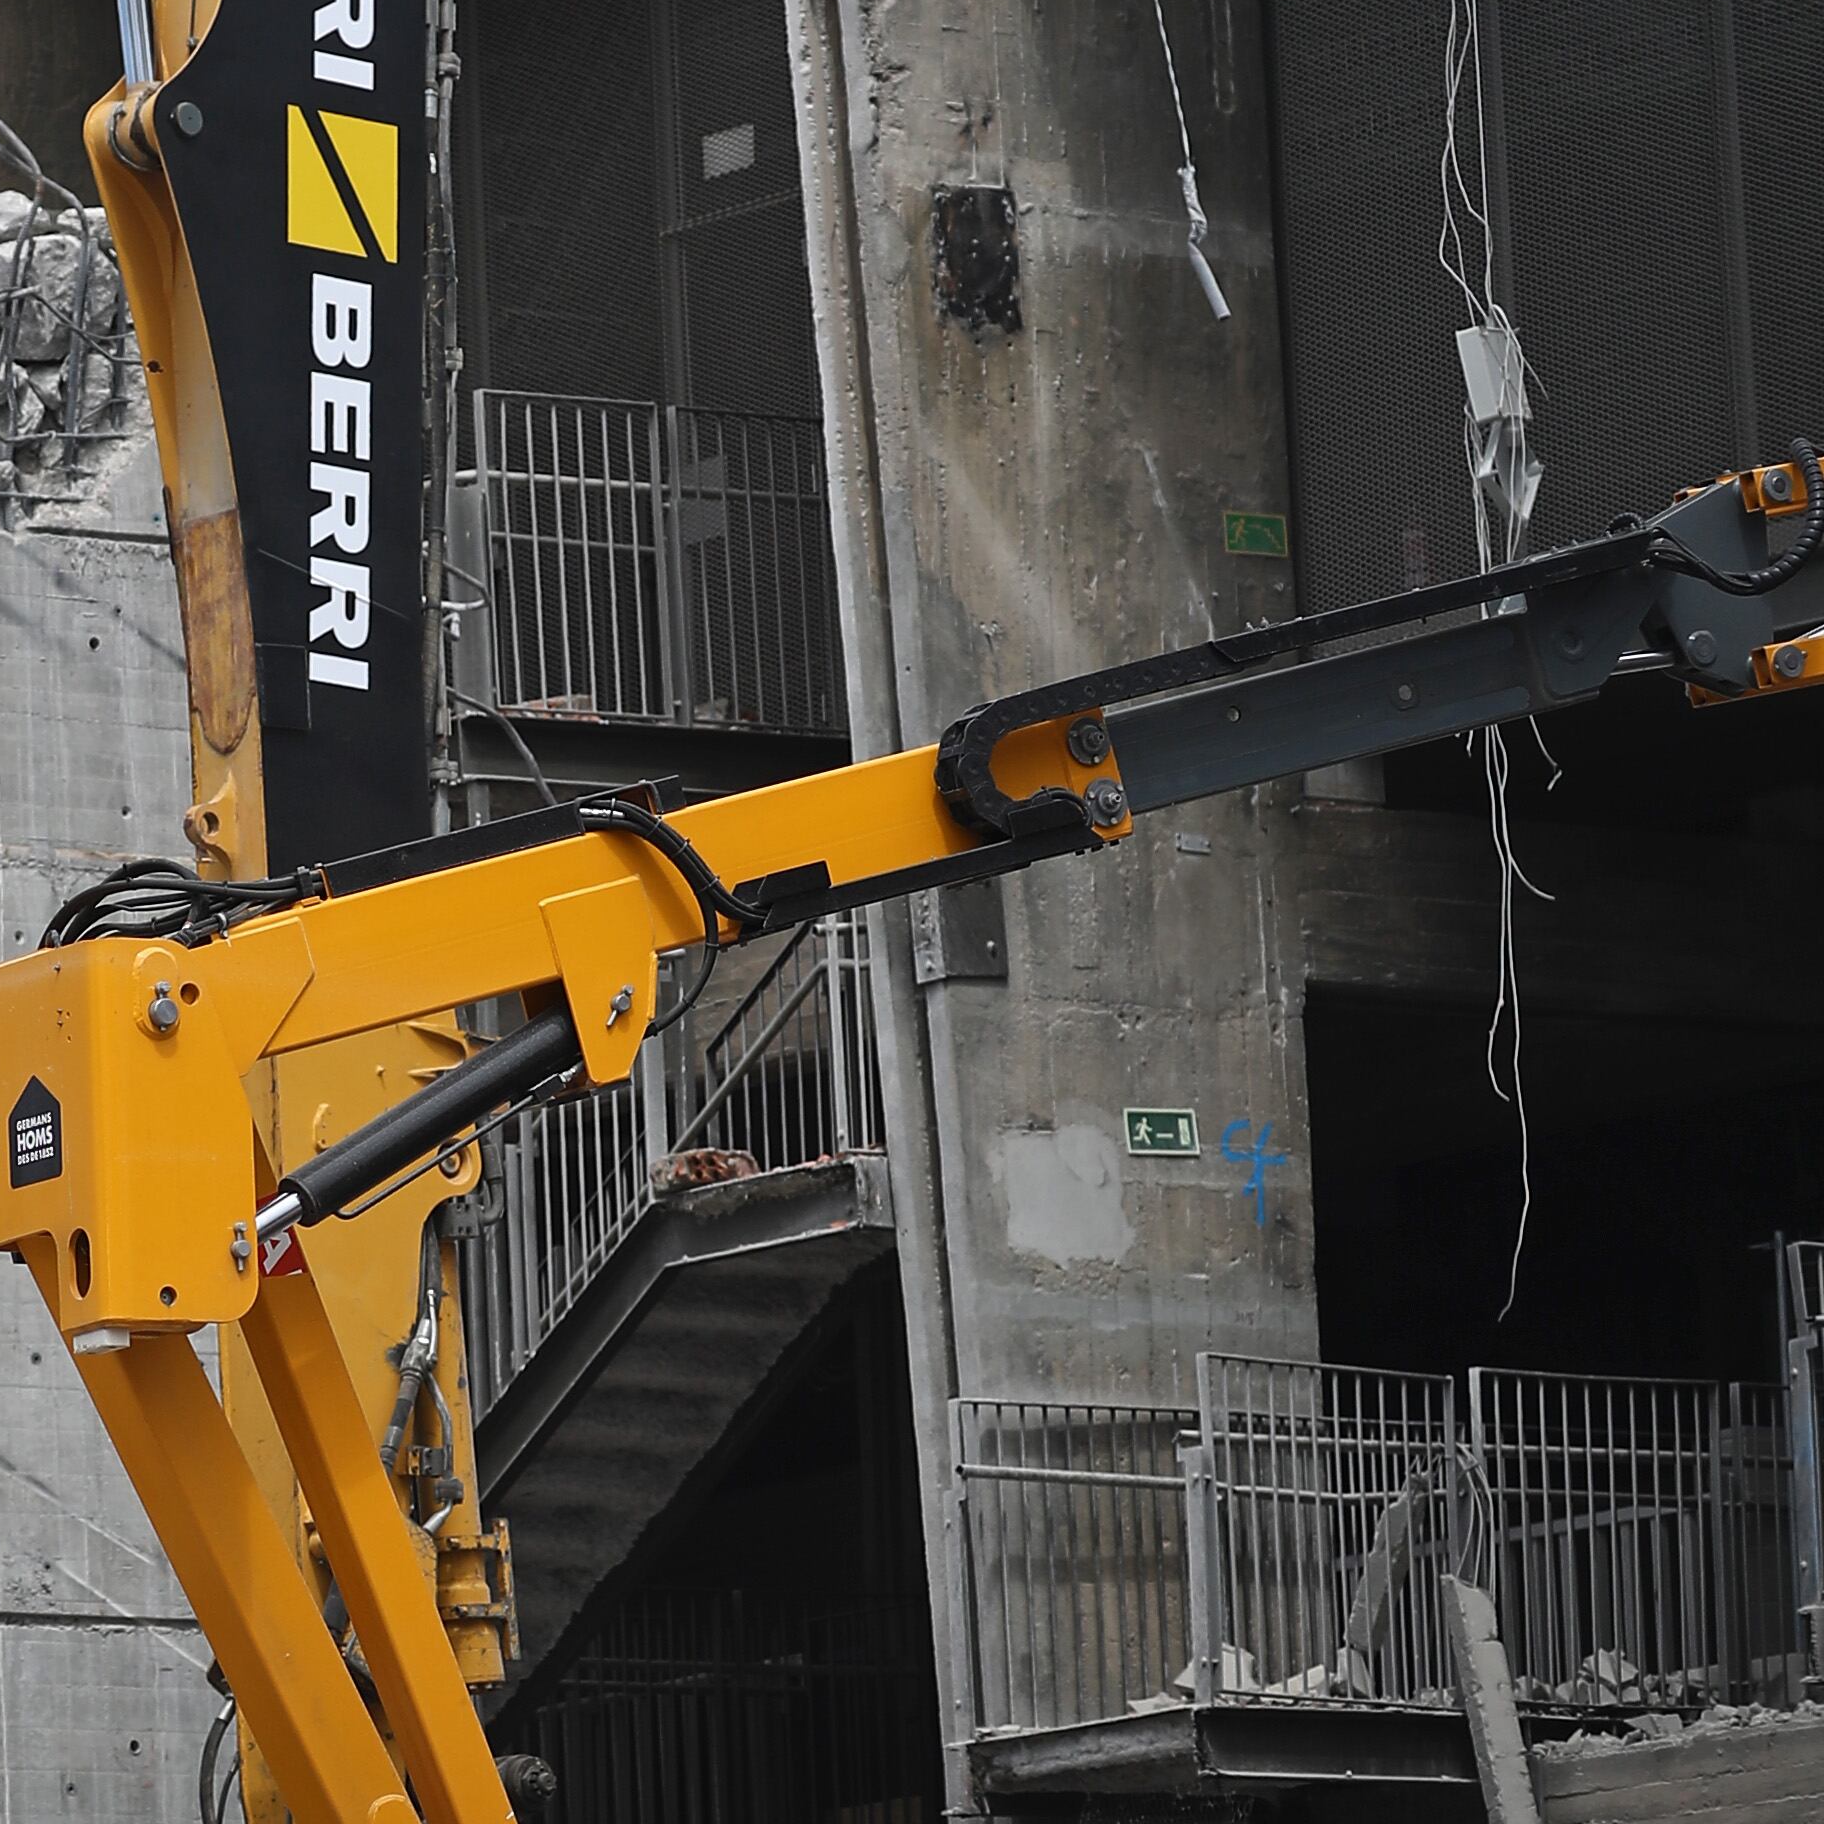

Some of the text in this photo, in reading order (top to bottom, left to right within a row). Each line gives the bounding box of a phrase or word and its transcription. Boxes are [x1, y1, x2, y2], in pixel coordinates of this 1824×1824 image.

[308, 273, 372, 690] BERRI
[16, 1111, 52, 1132] GERMANS
[16, 1125, 53, 1153] HOMS
[17, 1152, 30, 1166] DES
[30, 1150, 39, 1162] DE
